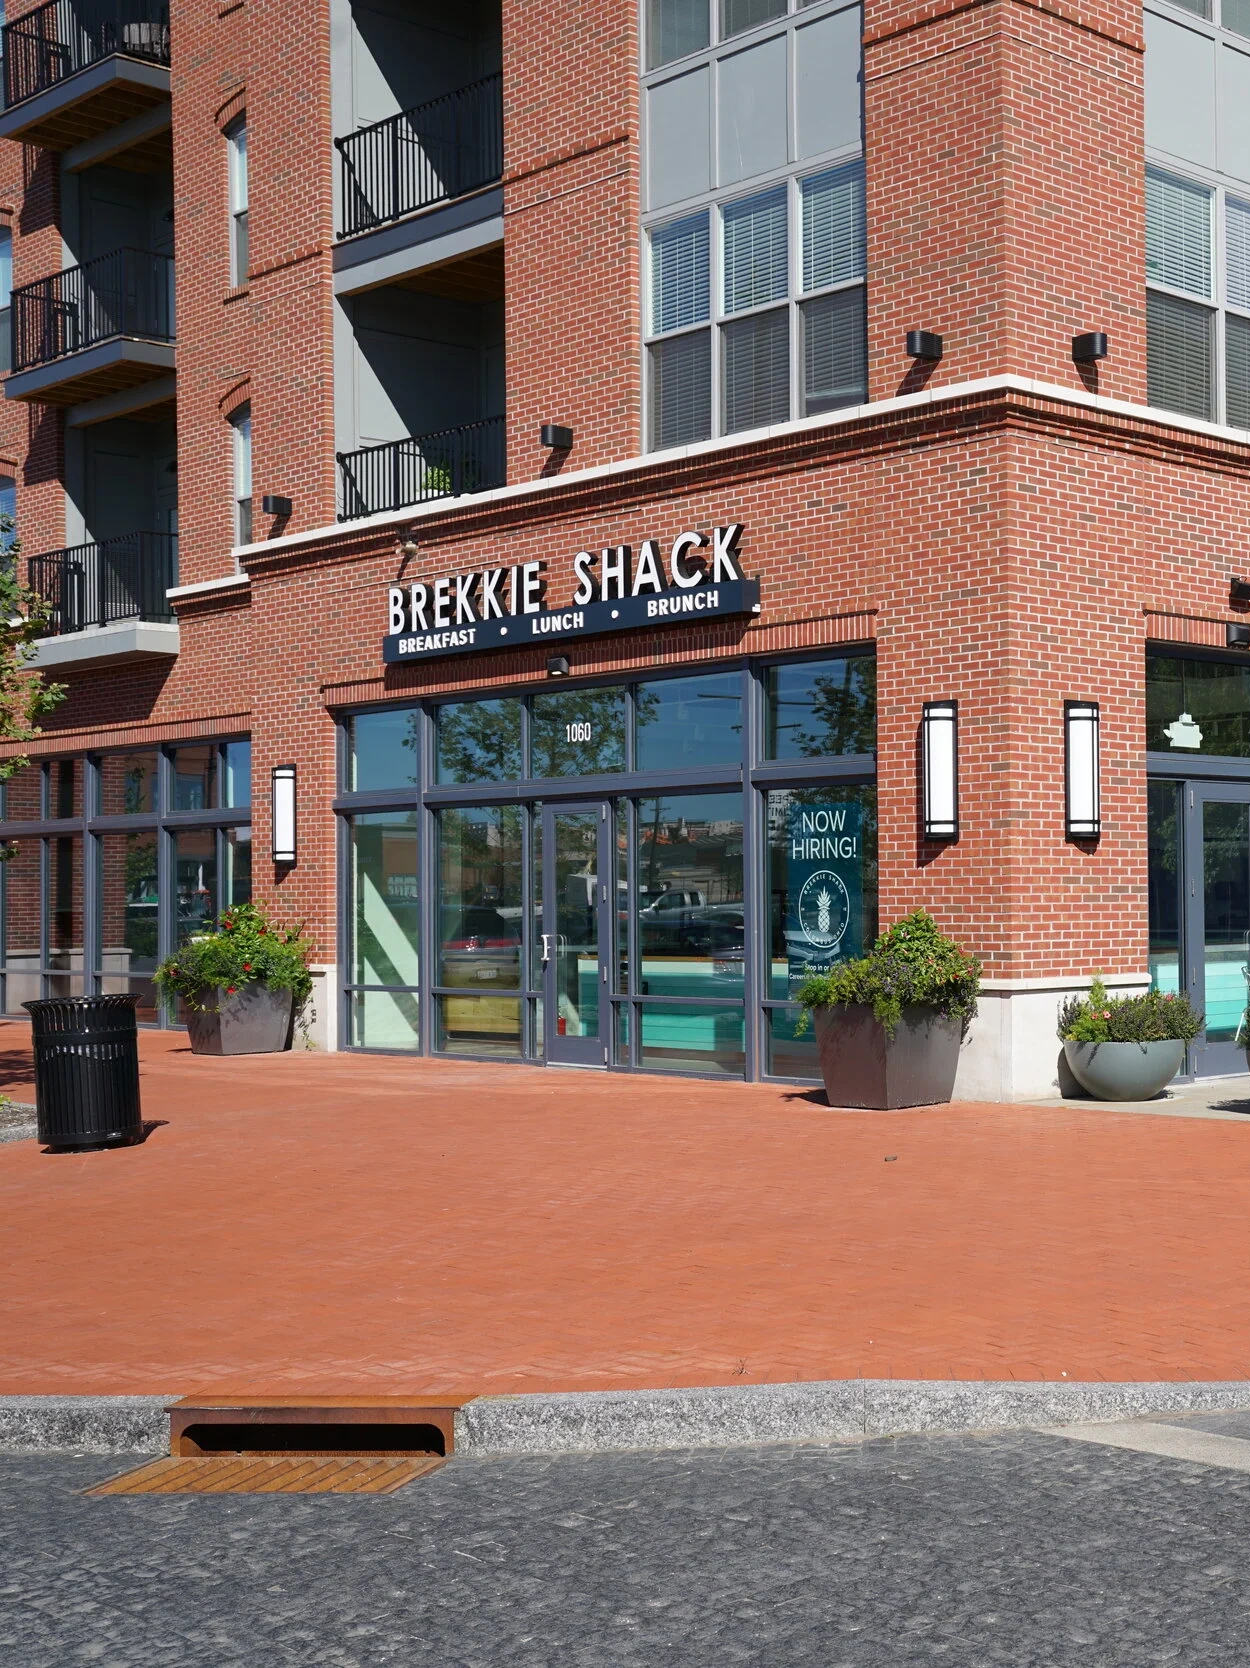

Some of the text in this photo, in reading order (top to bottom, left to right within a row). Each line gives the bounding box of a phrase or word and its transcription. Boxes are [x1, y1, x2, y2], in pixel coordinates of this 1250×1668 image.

[389, 524, 740, 635] BREKKIE SHACK
[398, 590, 719, 655] BREAKFAST LUNCH BRUNCH
[566, 722, 591, 742] 1060
[802, 810, 846, 832] NOW
[792, 837, 856, 859] HIRING!
